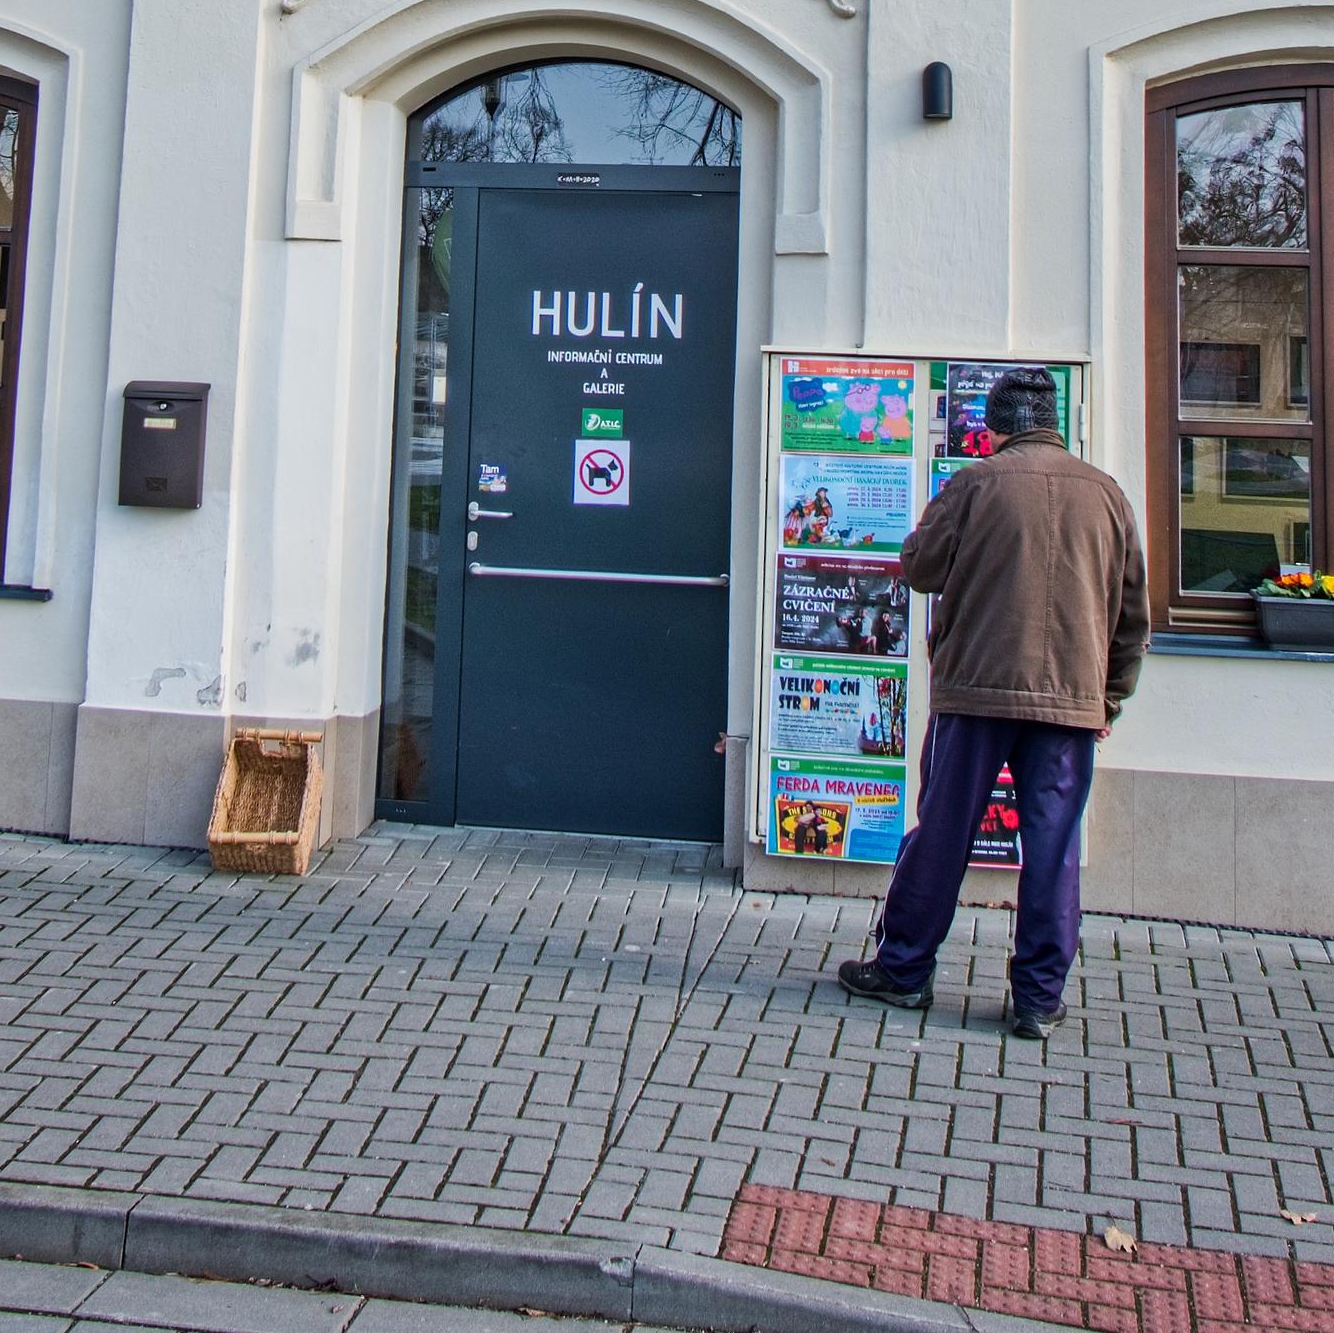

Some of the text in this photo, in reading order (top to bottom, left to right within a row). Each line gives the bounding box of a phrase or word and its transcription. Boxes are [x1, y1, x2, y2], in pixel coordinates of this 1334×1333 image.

[532, 282, 683, 339] HULÍN
[547, 349, 663, 365] INFORMAČNÍ CENTRUM
[600, 367, 609, 379] A
[583, 382, 625, 395] GALERIE
[783, 584, 849, 599] ZÁZRAČNÉ
[783, 598, 836, 613] CVIČENÍ
[779, 676, 860, 696] VELIKONOČNÍ
[779, 694, 820, 711] STROM
[777, 776, 900, 797] FERDA MRAVENEC
